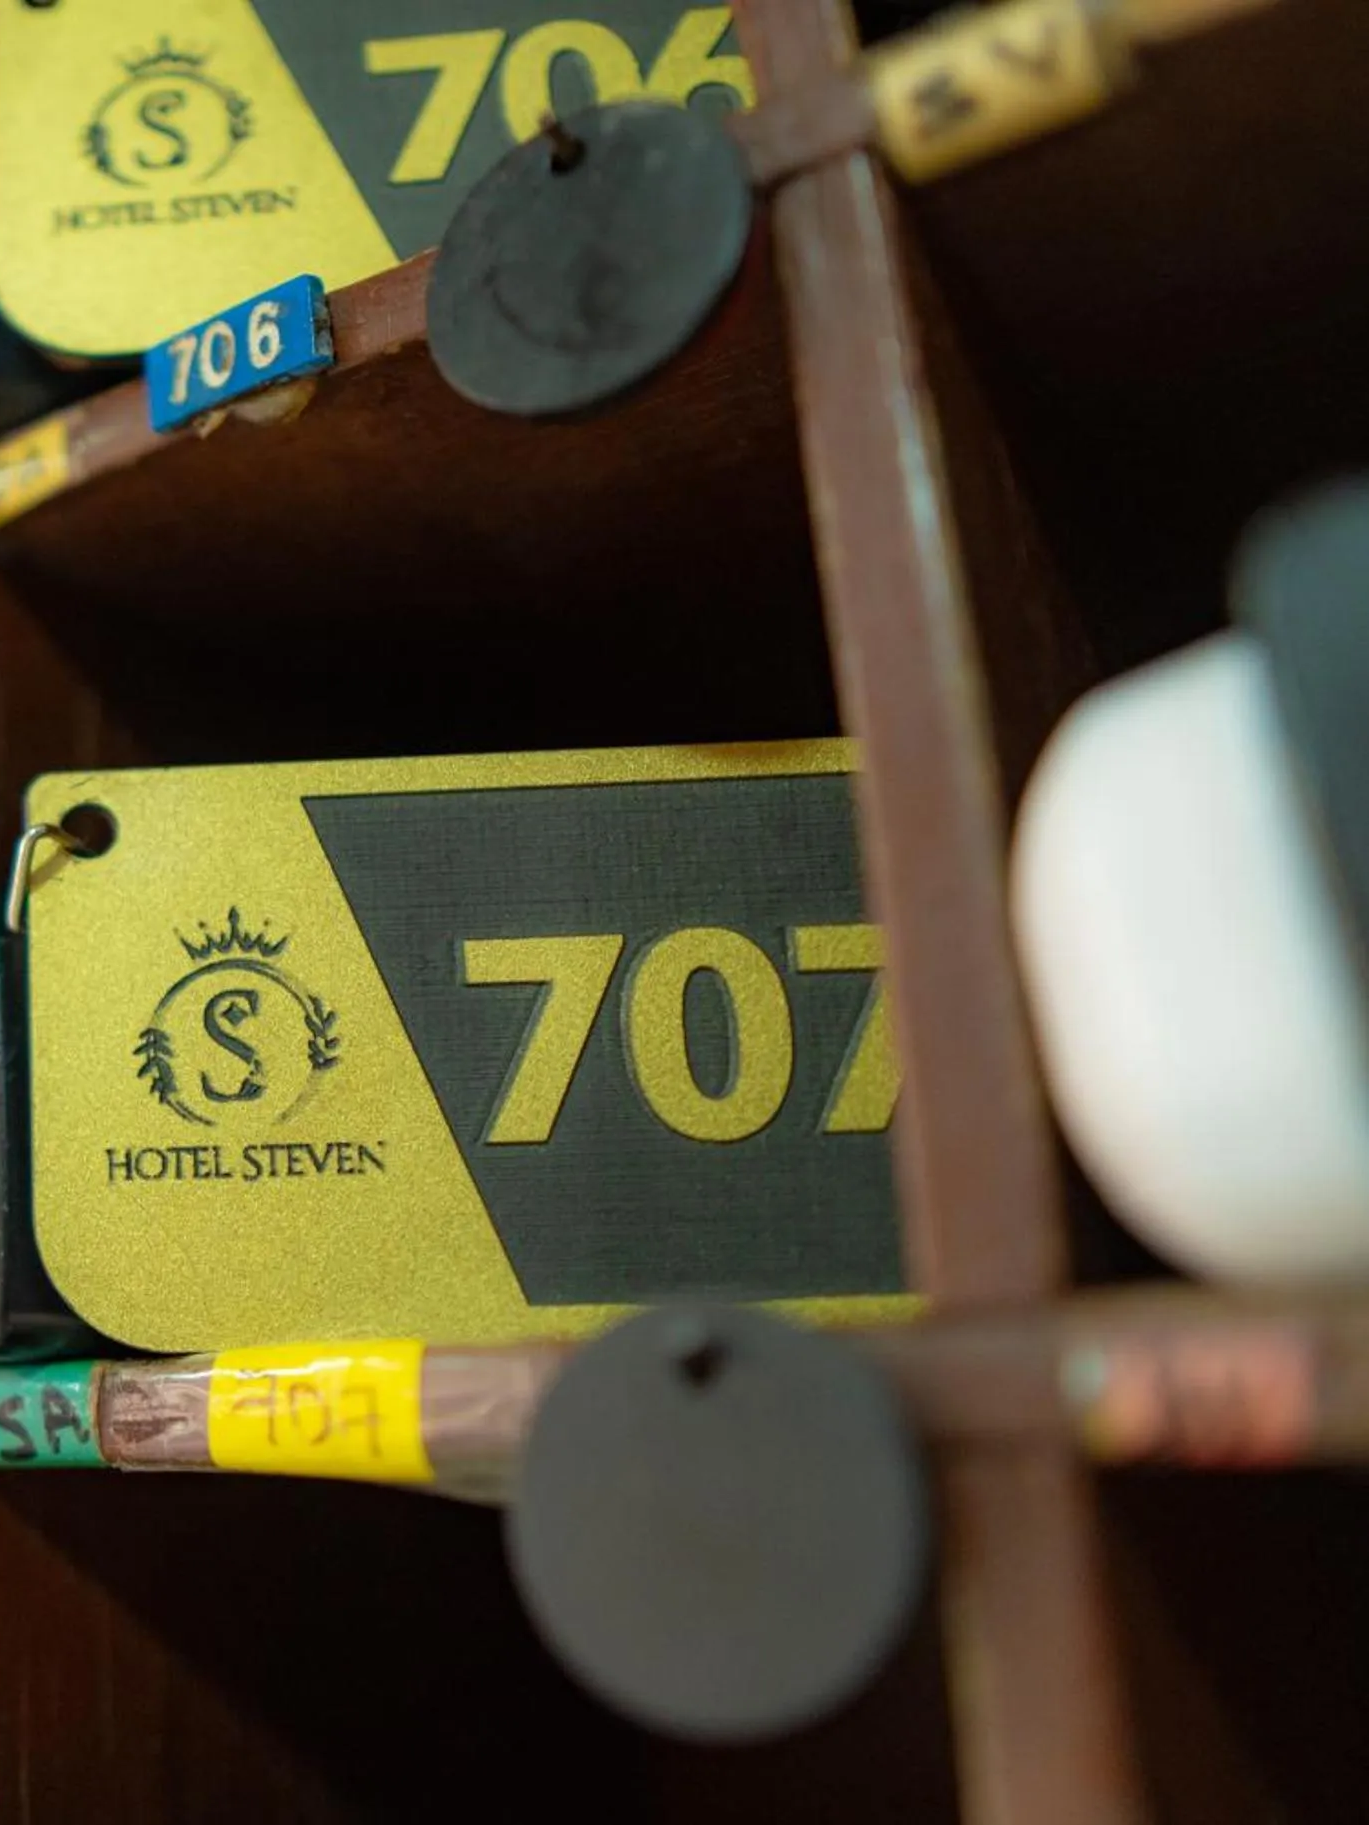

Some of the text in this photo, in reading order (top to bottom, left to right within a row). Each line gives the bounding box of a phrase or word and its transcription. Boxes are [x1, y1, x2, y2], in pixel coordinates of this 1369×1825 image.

[51, 186, 296, 232] HOTEL STEVEN
[167, 300, 281, 406] 706
[458, 923, 905, 1147] 707
[106, 1140, 387, 1183] HOTEL STEVEN
[230, 1372, 384, 1458] 707
